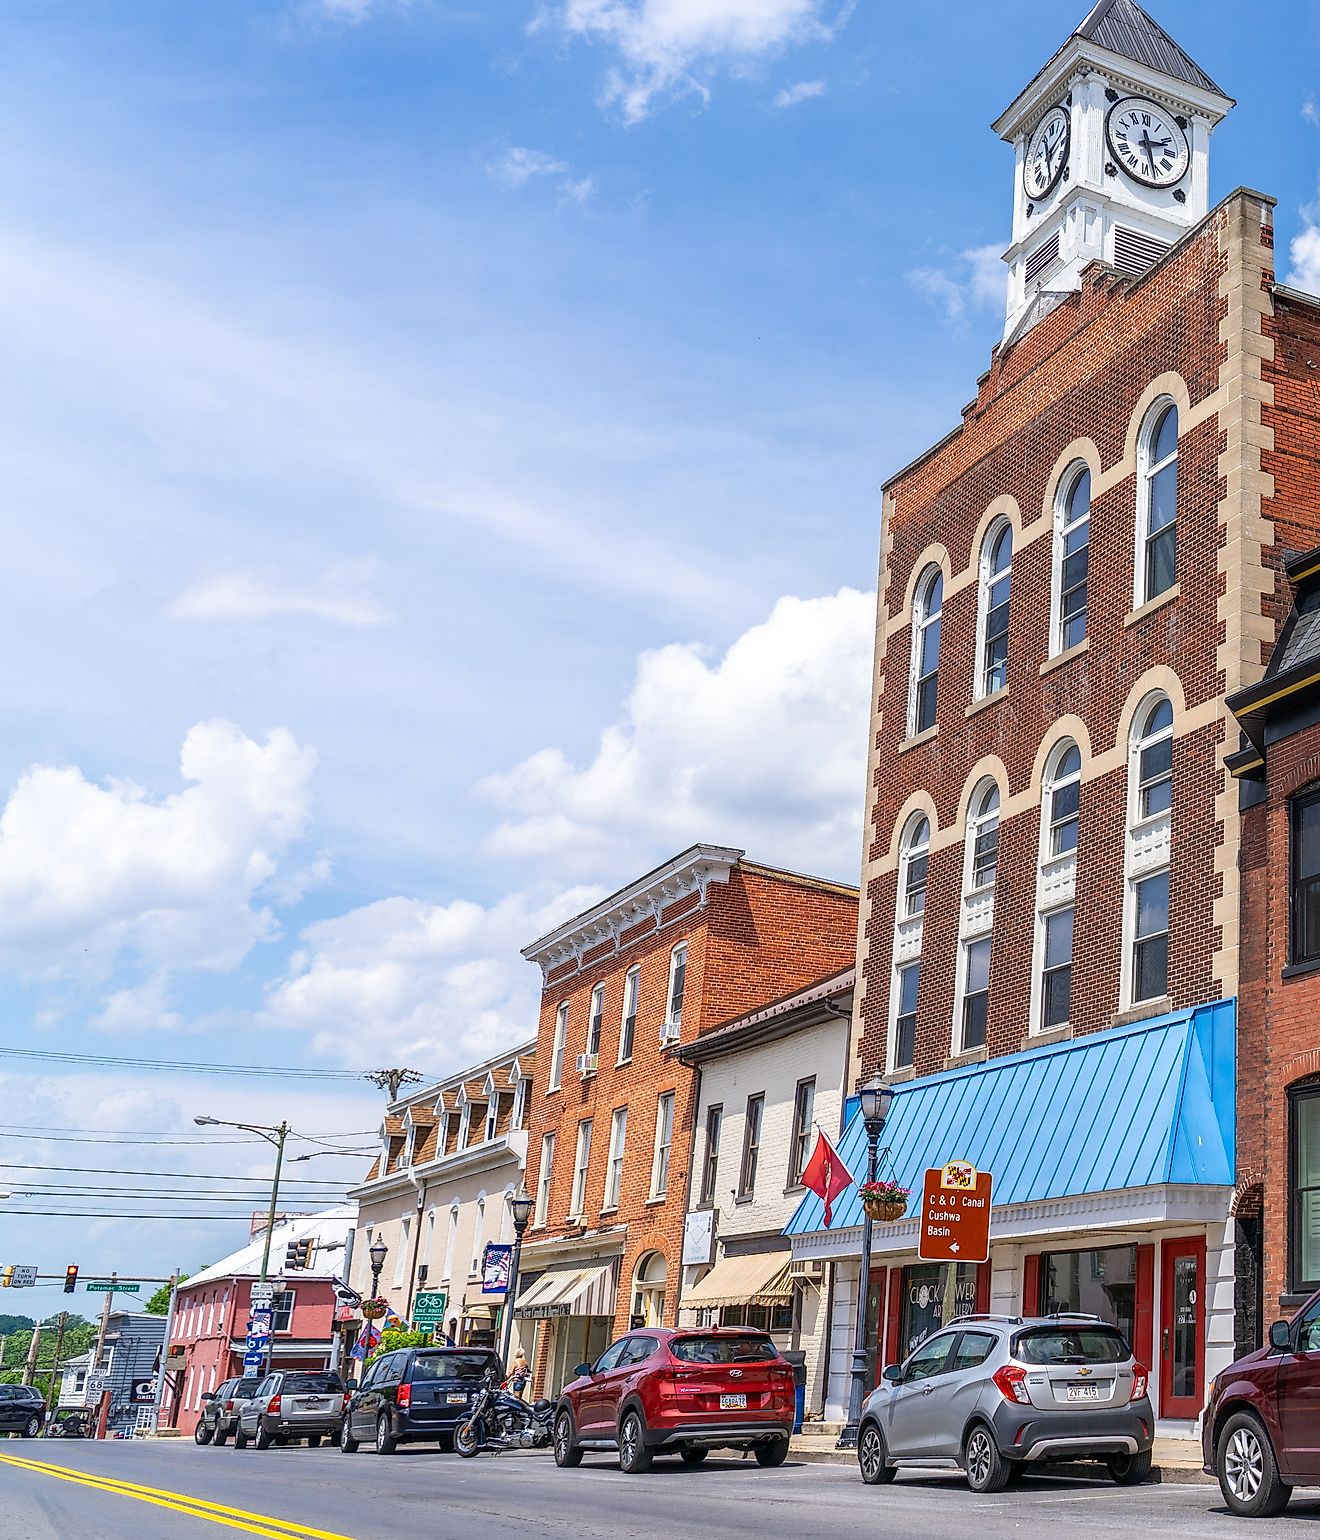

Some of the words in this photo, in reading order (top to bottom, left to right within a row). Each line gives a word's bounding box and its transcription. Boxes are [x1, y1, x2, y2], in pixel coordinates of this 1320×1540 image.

[930, 1195, 935, 1204] C
[939, 1195, 946, 1205] &
[950, 1196, 955, 1205] O
[962, 1197, 984, 1207] Canal
[929, 1210, 960, 1221] Cushwa
[928, 1226, 950, 1236] Basin
